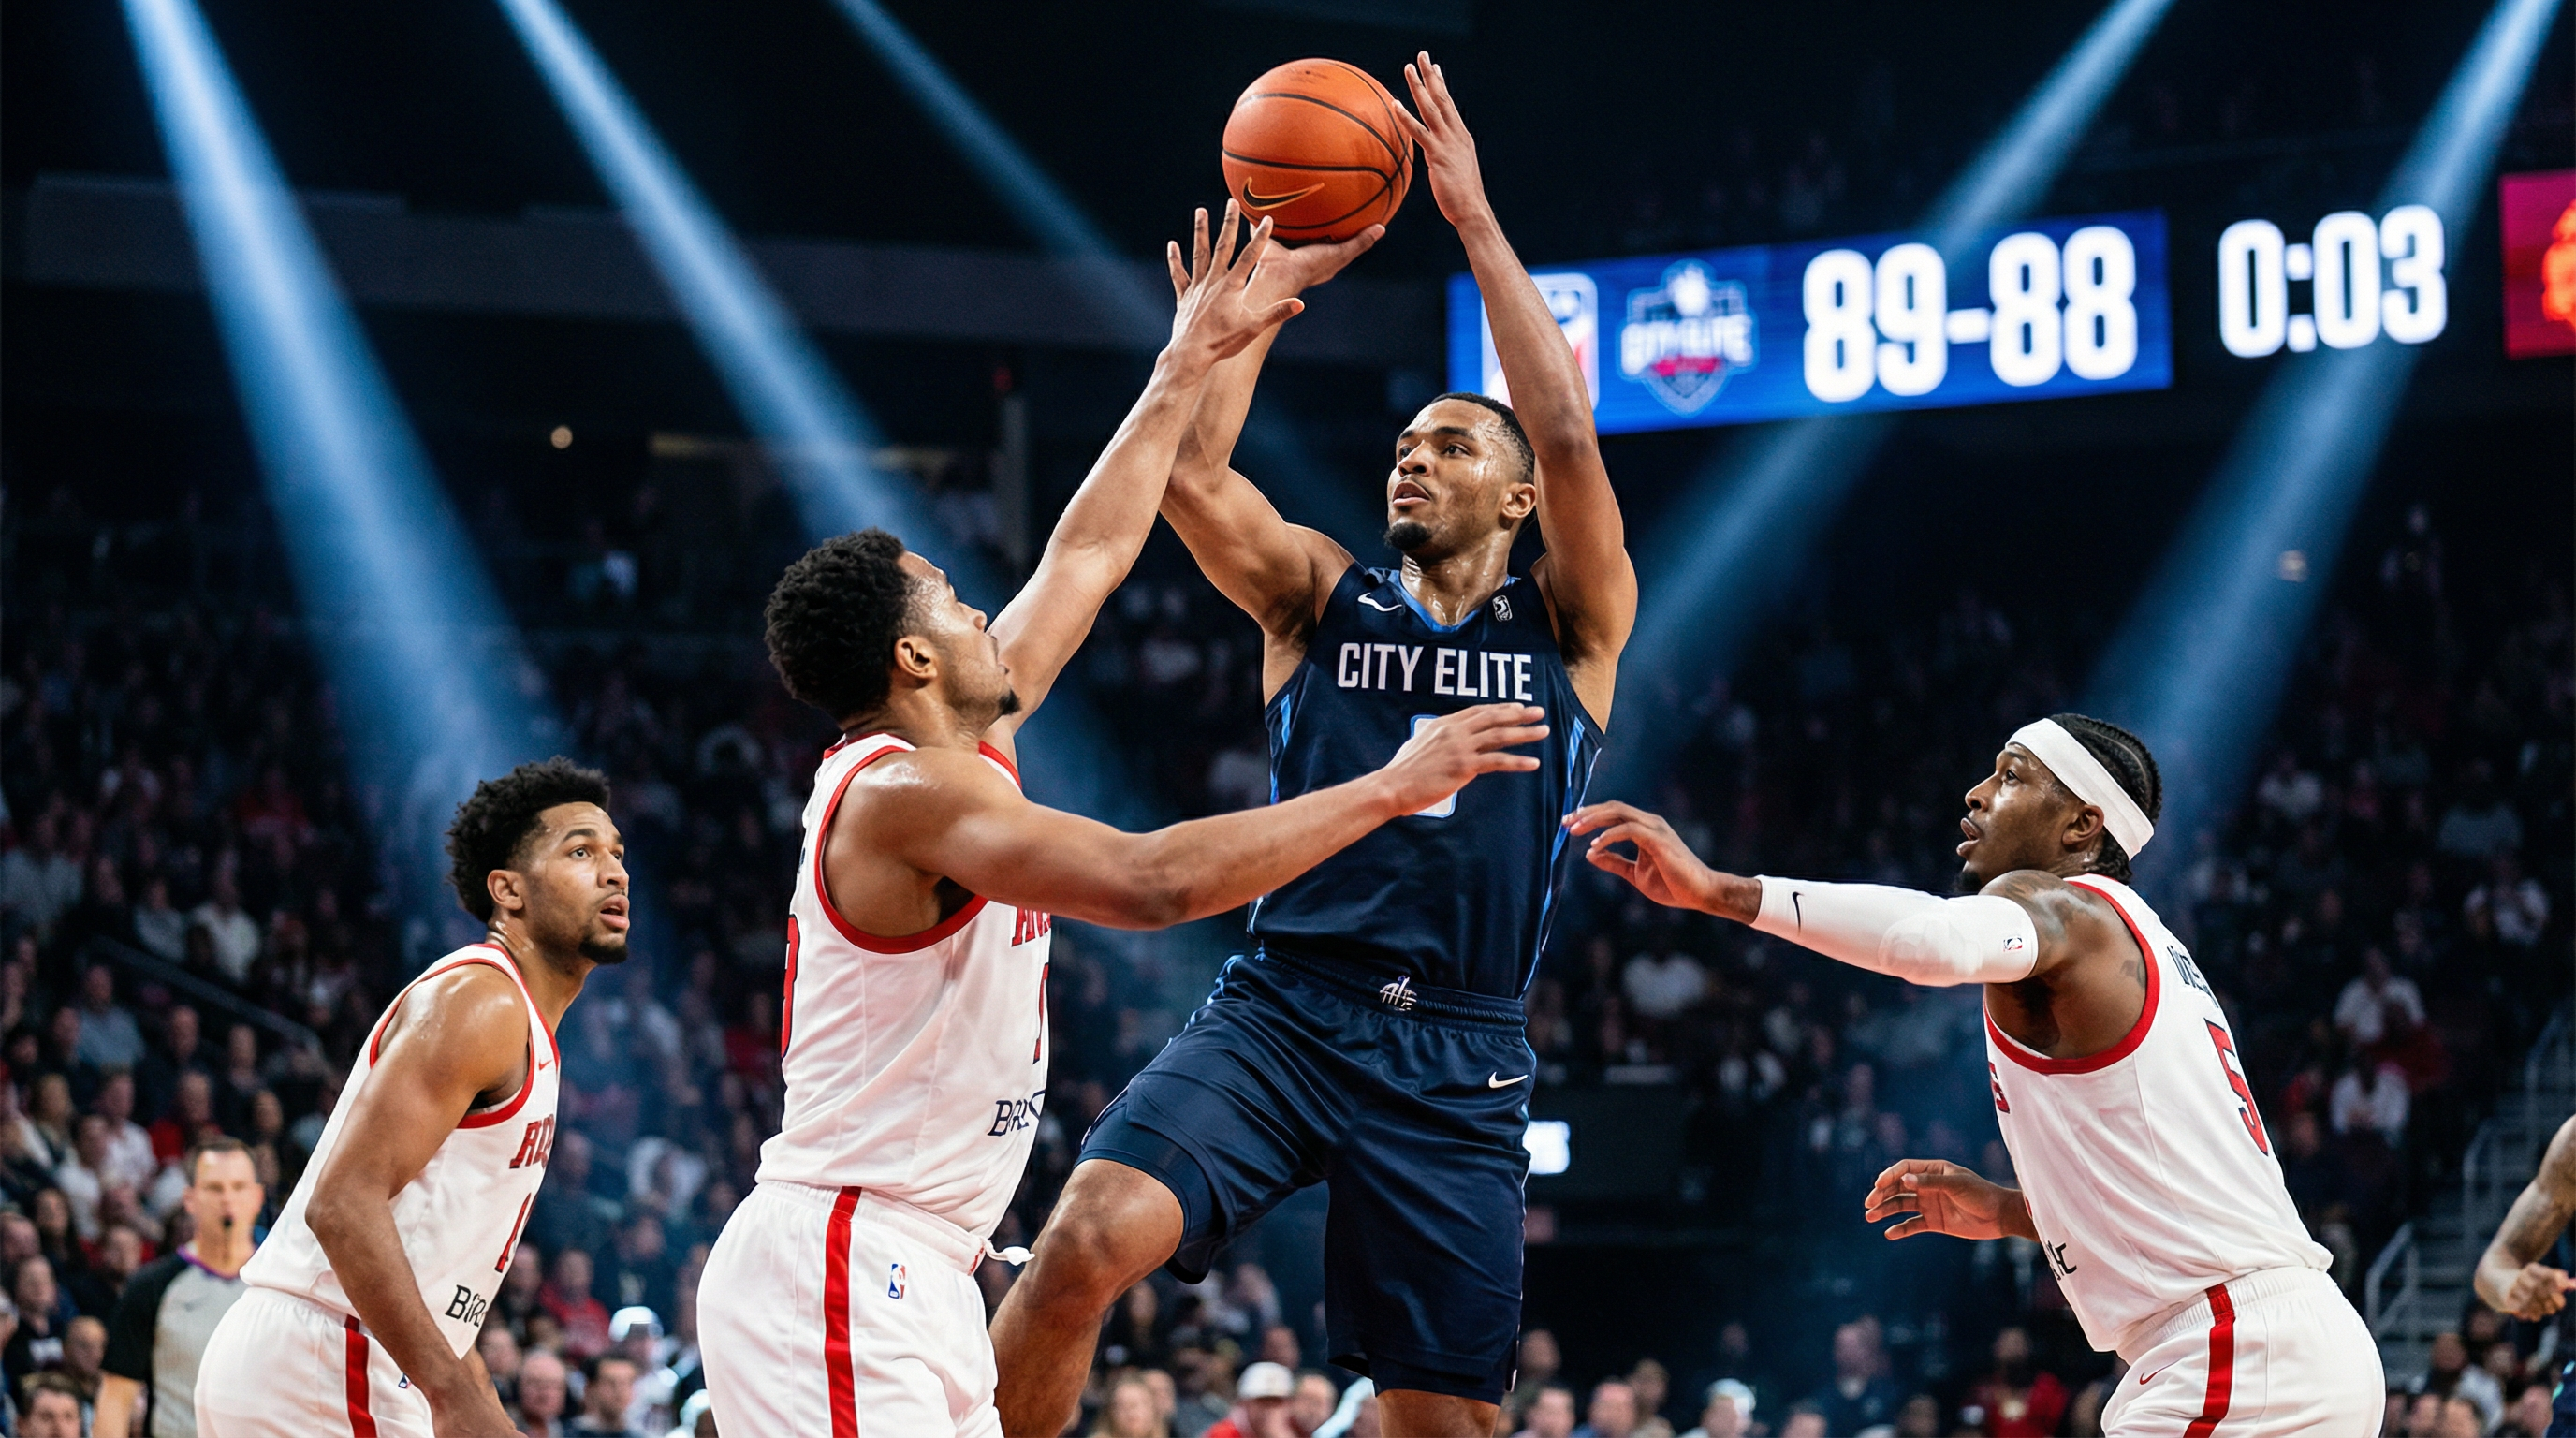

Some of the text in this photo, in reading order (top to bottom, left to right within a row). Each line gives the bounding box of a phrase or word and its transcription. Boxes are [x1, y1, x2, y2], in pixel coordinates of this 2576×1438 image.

[1802, 225, 2139, 404] 89-88
[2217, 203, 2447, 358] 0:03
[1337, 641, 1534, 702] CITY ELITE
[2204, 1017, 2270, 1157] 5
